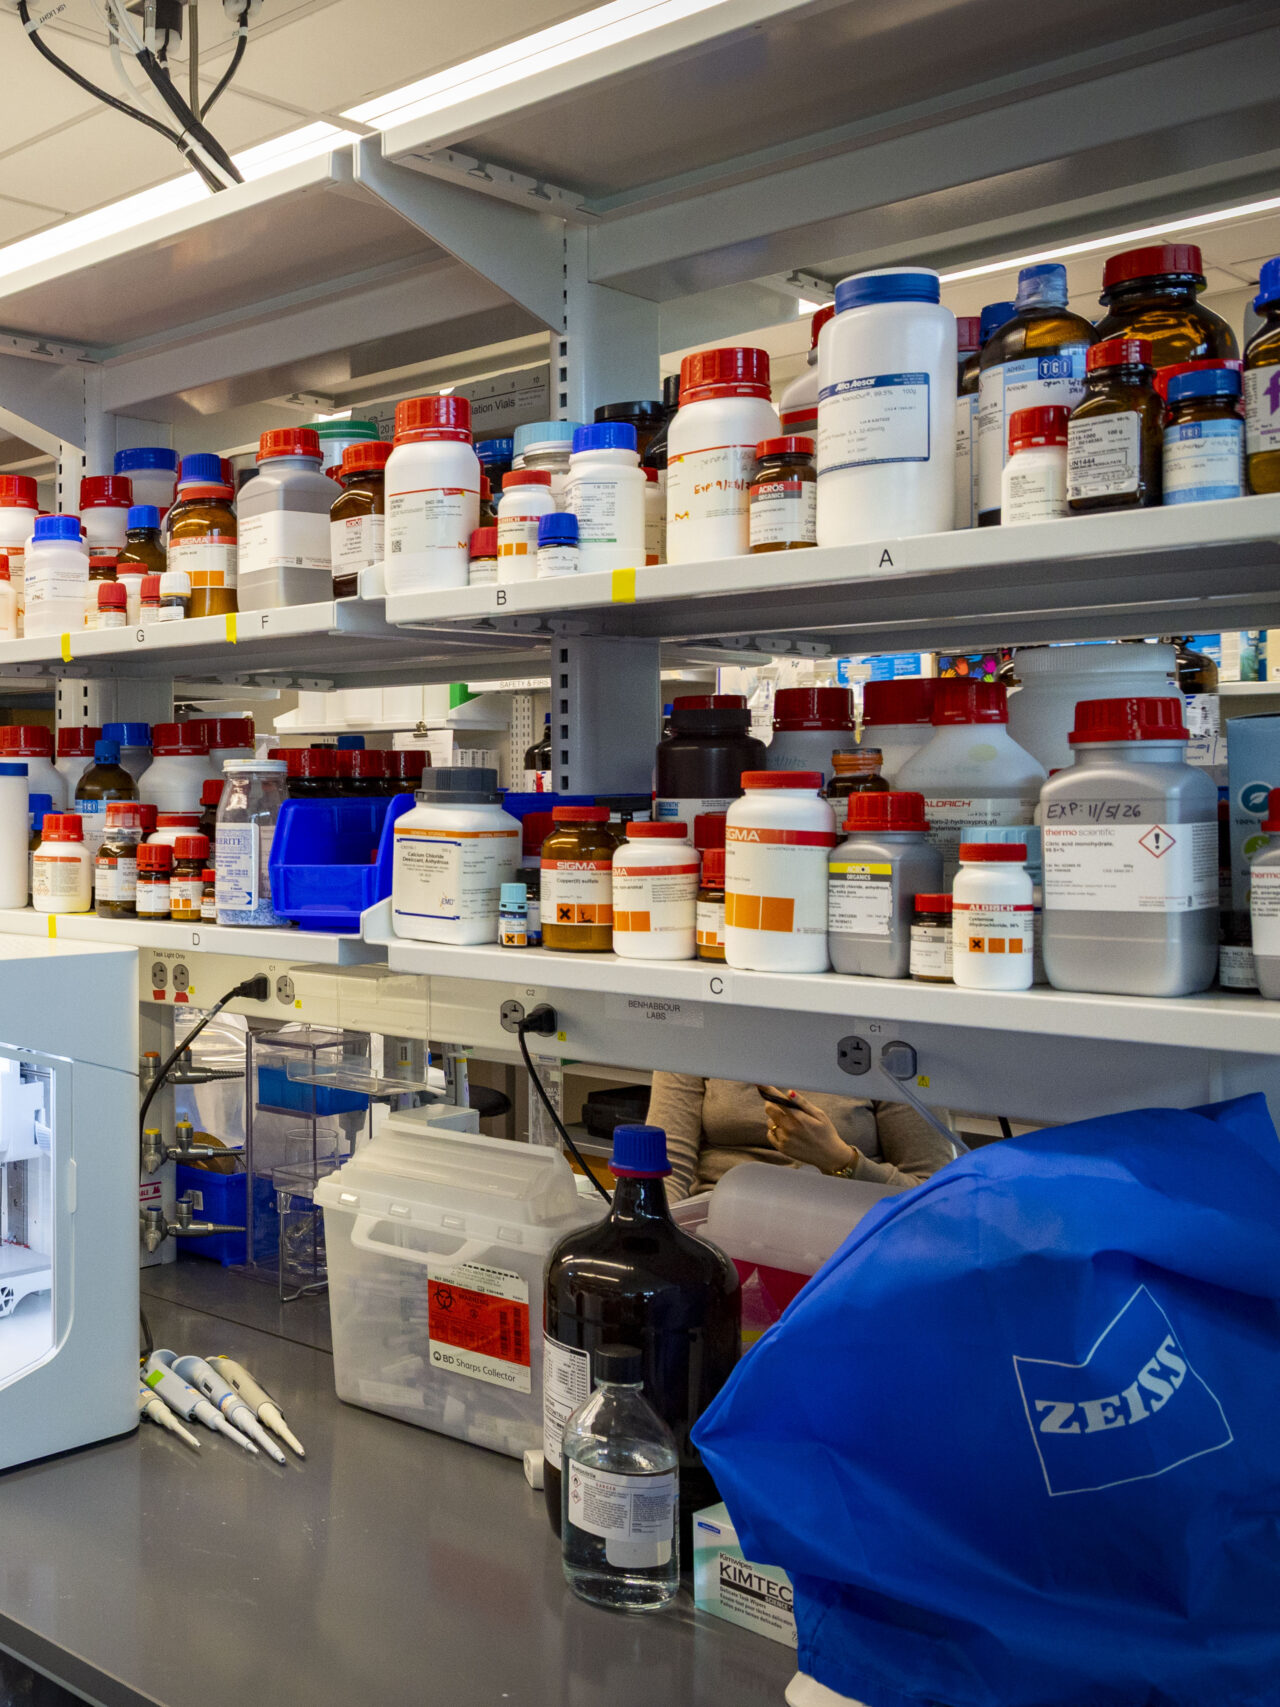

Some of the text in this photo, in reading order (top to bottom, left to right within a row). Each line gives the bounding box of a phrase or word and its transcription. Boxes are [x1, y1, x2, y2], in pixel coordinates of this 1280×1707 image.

[1040, 360, 1070, 377] TCI
[495, 398, 516, 410] Vials
[758, 484, 784, 494] ACROS
[758, 492, 784, 500] ORGANICS
[179, 537, 209, 546] SIGMA
[879, 548, 894, 568] A
[496, 590, 507, 606] B
[261, 615, 269, 630] F
[136, 629, 145, 642] G
[1046, 802, 1083, 819] EXP:
[1046, 828, 1116, 836] thermo scientific
[556, 861, 596, 870] SIGMA
[613, 867, 628, 876] GMA
[442, 898, 454, 906] EMD
[968, 904, 1014, 912] ALDRICH
[192, 932, 200, 946] D
[164, 952, 174, 960] Light
[176, 952, 186, 960] Only
[710, 977, 724, 994] C
[526, 989, 536, 997] C2
[628, 1000, 681, 1012] BENHABBOUR
[646, 1012, 666, 1020] LABS
[869, 1024, 882, 1033] C1
[442, 1354, 516, 1382] BD Sharps Collector
[1034, 1334, 1187, 1434] ZEISS
[720, 1552, 753, 1570] Kimwipes
[720, 1562, 792, 1602] KIMTEC
